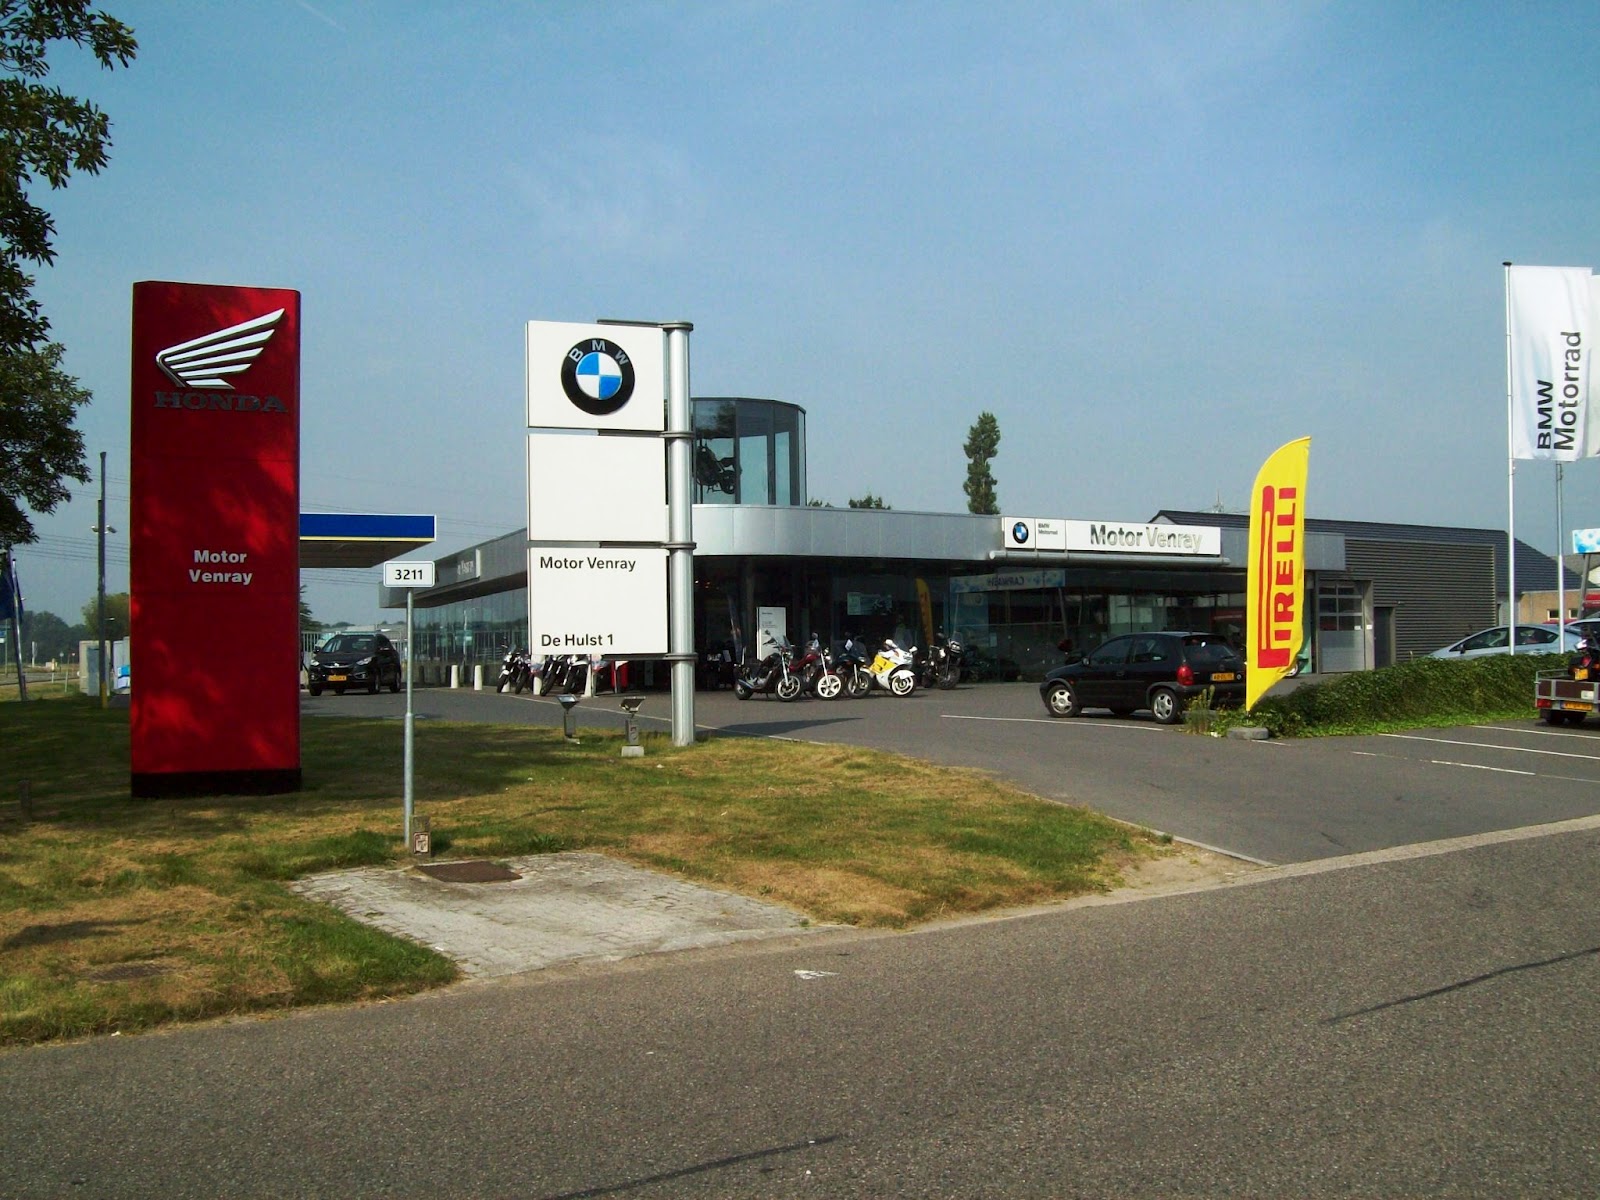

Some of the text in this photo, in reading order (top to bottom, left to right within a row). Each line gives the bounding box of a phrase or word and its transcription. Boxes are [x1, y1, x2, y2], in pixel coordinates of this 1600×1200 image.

[569, 340, 628, 366] BMW
[154, 391, 288, 413] HONDA
[1554, 331, 1581, 451] Motorrad
[1537, 379, 1554, 450] BMW
[1090, 524, 1203, 554] Motor Venray
[194, 549, 247, 565] Motor
[540, 556, 636, 573] Motor Venray
[189, 568, 253, 586] Venray
[395, 569, 423, 580] 3211
[1257, 485, 1297, 669] PIRELLI
[541, 633, 614, 647] De Hulst 1
